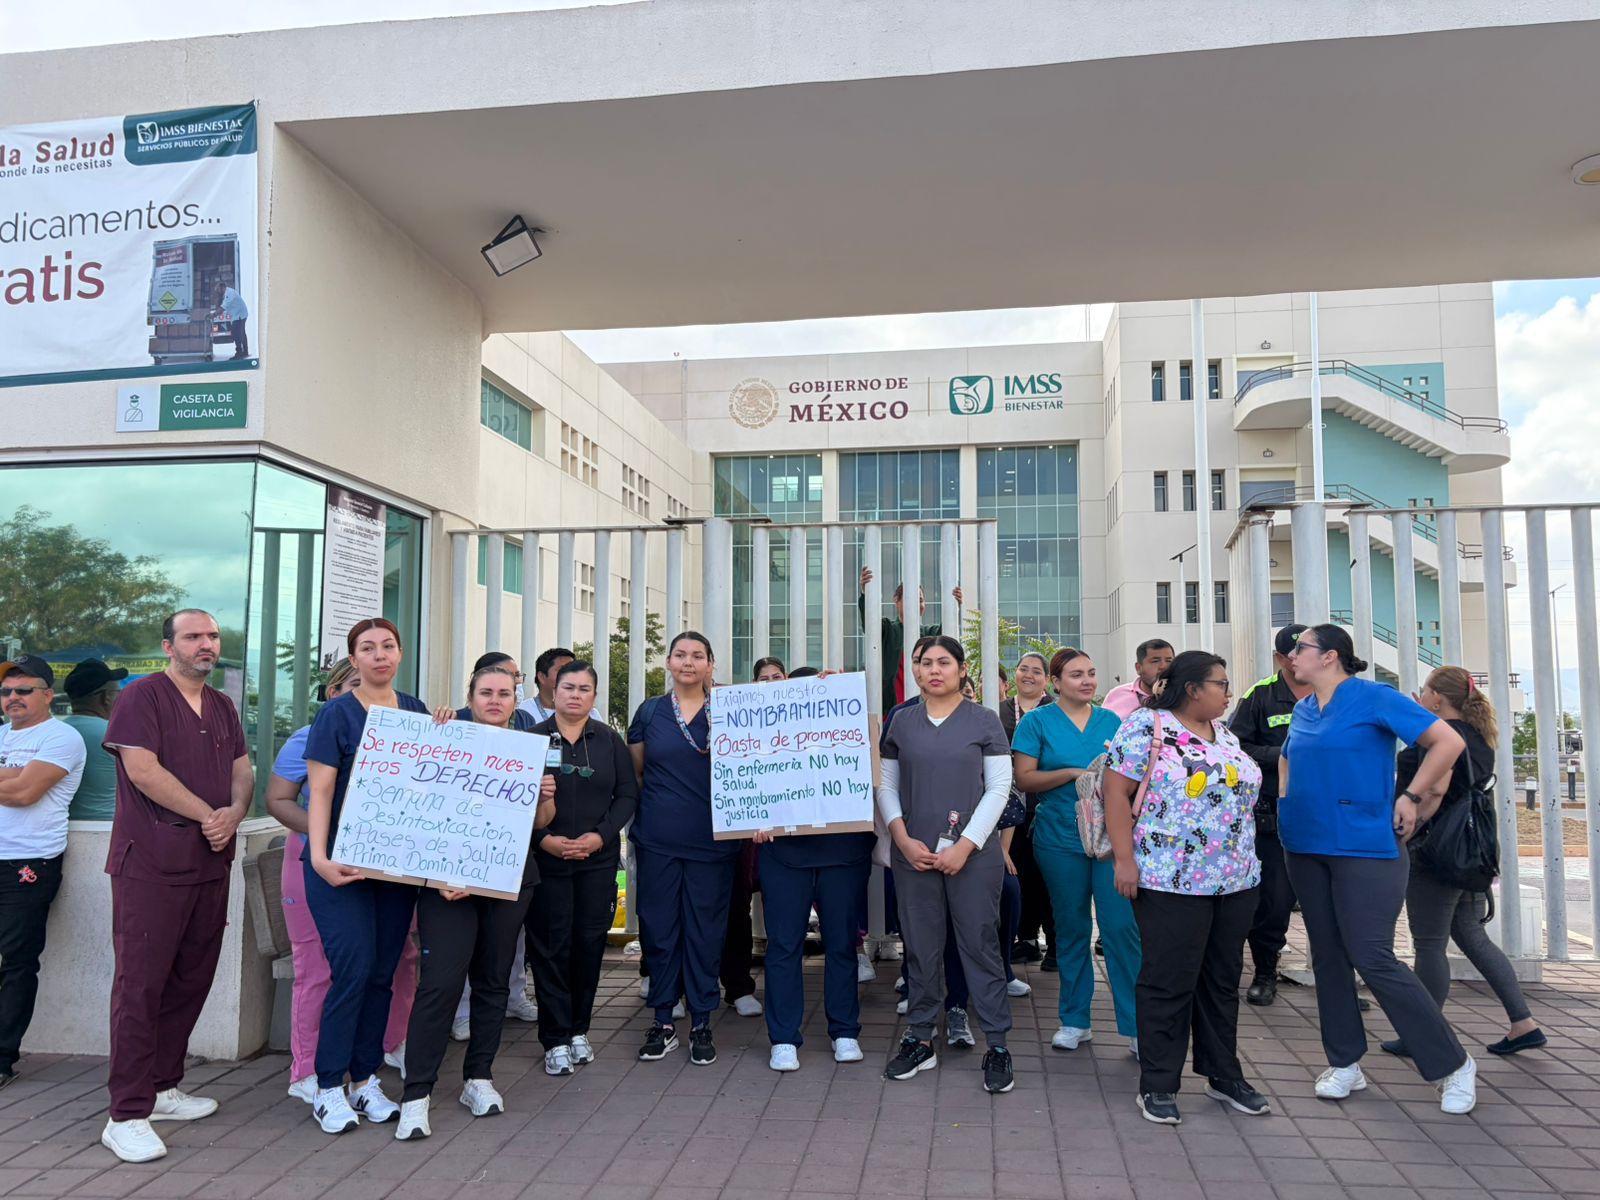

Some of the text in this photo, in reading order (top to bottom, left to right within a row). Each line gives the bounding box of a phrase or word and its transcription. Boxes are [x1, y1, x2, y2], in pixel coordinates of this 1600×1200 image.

[160, 125, 186, 137] IMSS
[35, 132, 115, 163] Salud
[137, 142, 173, 153] SERVICIOS
[32, 164, 50, 174] las
[55, 158, 113, 173] necesitas
[788, 378, 882, 394] GOBIERNO
[885, 377, 908, 390] DE
[1004, 373, 1063, 395] IMSS
[173, 393, 233, 405] CASETA DE
[788, 393, 909, 423] MÉXICO
[1005, 400, 1064, 412] BIENESTAR
[172, 408, 235, 419] VIGILANCIA
[773, 682, 827, 701] nuestro
[362, 728, 385, 751] Se
[391, 741, 473, 765] respeten
[714, 728, 863, 756] Basta de promesas
[714, 760, 733, 780] Sin
[809, 754, 829, 769] NO
[834, 753, 859, 771] hay
[357, 754, 537, 806] tros DERECHOS
[714, 778, 870, 809] Sin nombramiento NO hay
[455, 796, 483, 817] de
[354, 821, 416, 850] Pases
[425, 837, 449, 853] de
[349, 842, 398, 868] Prima
